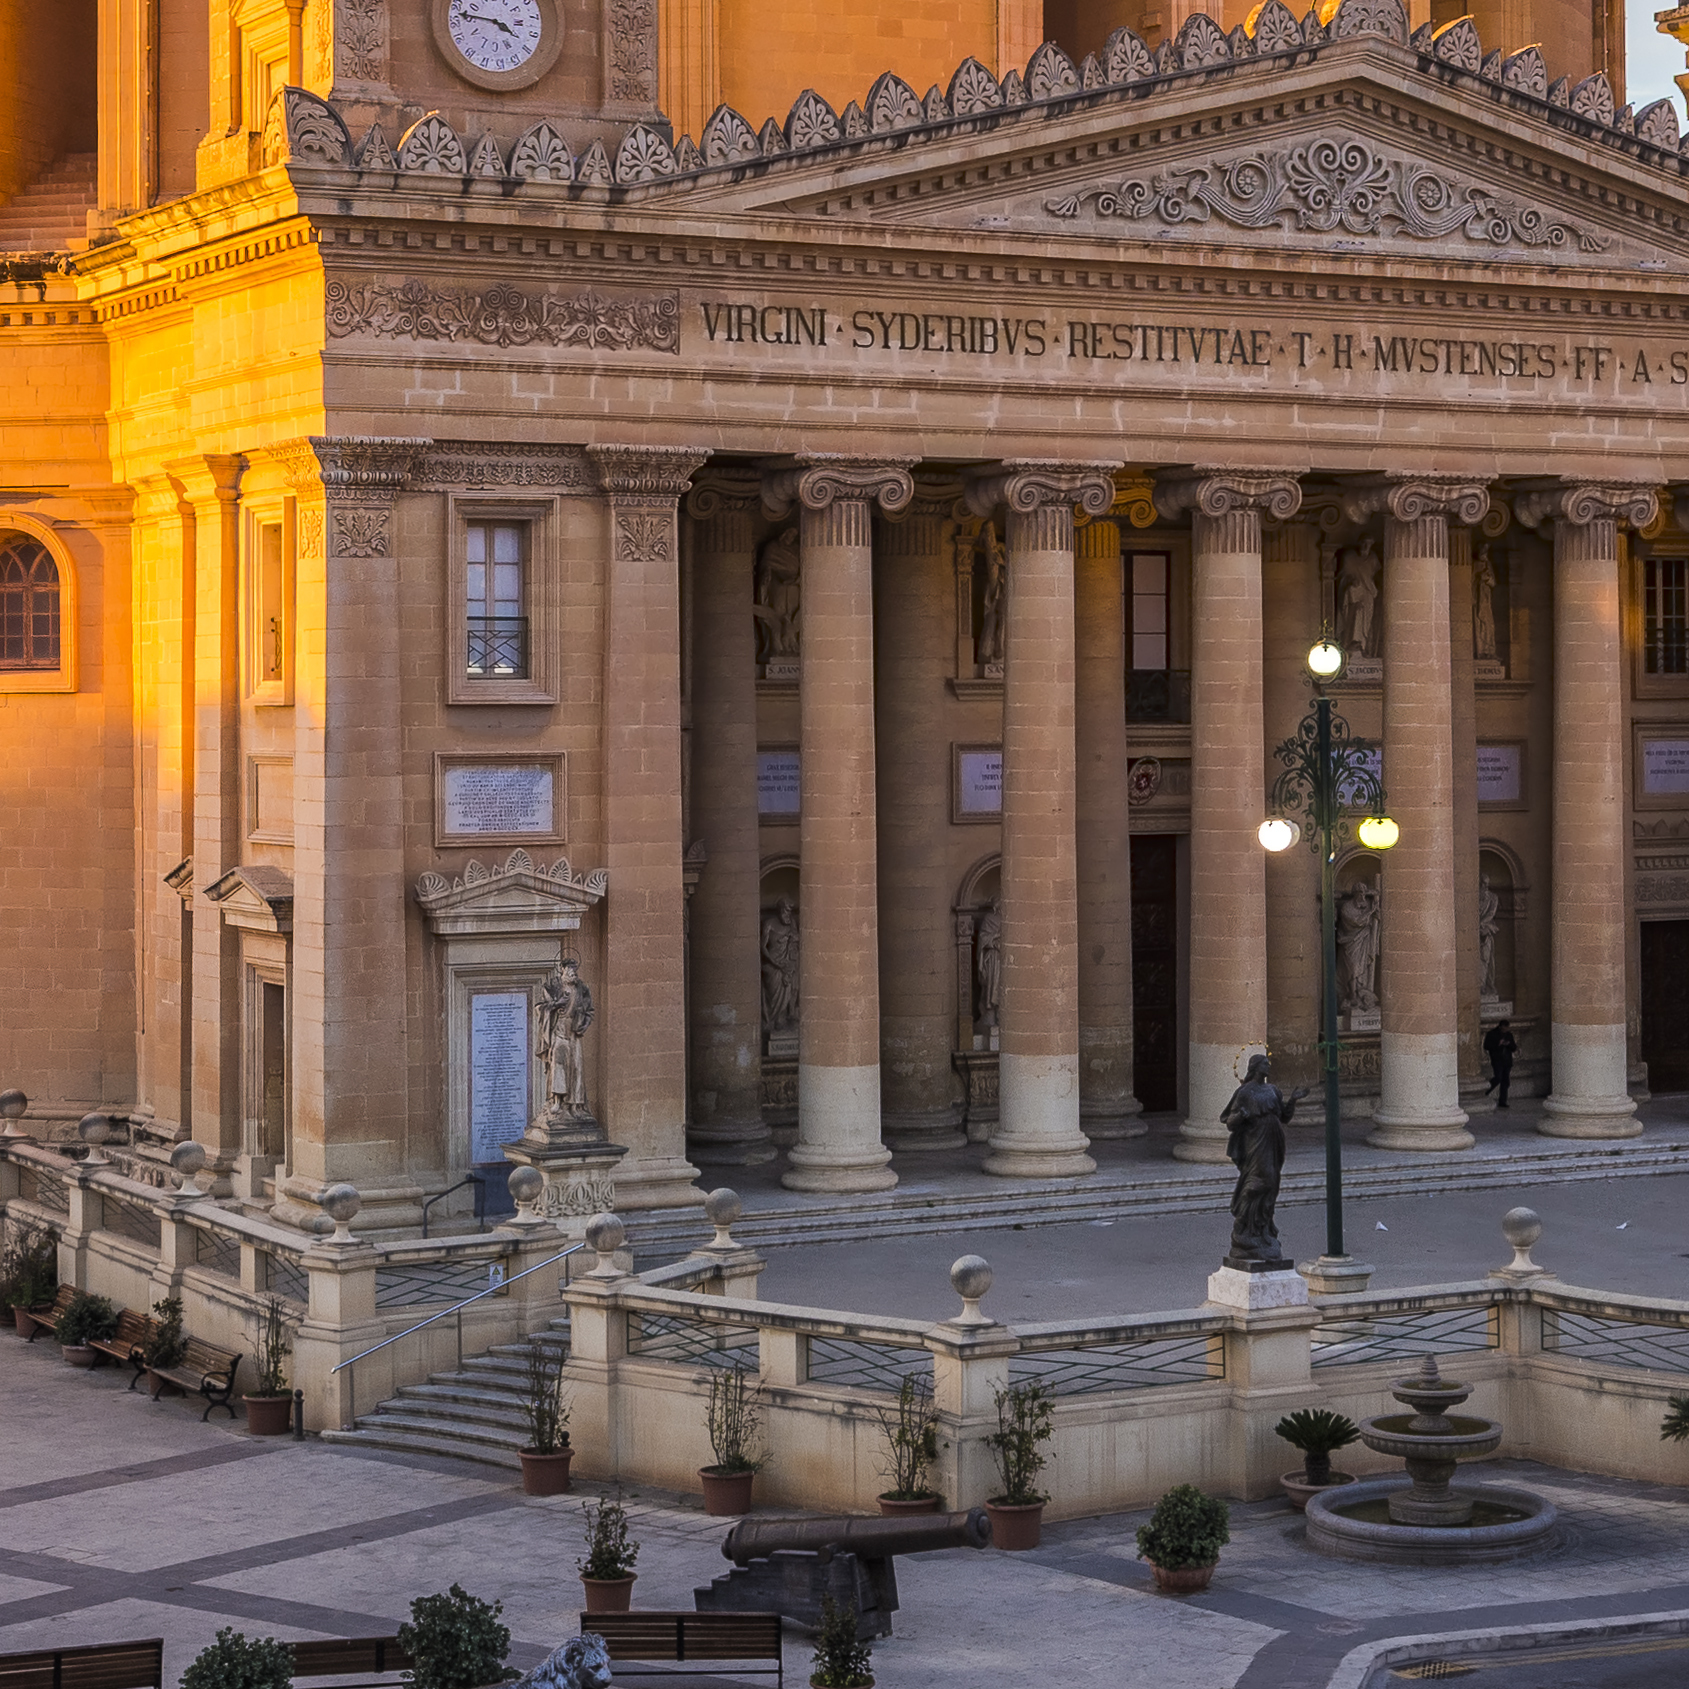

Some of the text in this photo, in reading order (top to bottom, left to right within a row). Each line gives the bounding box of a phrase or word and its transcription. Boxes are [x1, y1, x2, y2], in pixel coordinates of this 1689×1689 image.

[470, 3, 479, 11] O
[453, 33, 465, 44] 21
[481, 37, 488, 48] L
[465, 47, 476, 59] 19
[522, 45, 532, 54] 11
[480, 58, 489, 68] 17
[496, 58, 504, 69] 15
[700, 303, 828, 346] VIRGINI
[852, 310, 1046, 357] SYDERIBVS
[1067, 321, 1271, 366] RESTITVTAE
[1291, 331, 1312, 368] T
[1333, 333, 1353, 370] H
[1373, 335, 1556, 378] MVSTENSES
[1574, 346, 1612, 381] FF
[1632, 349, 1652, 383] A
[1670, 351, 1689, 385] S
